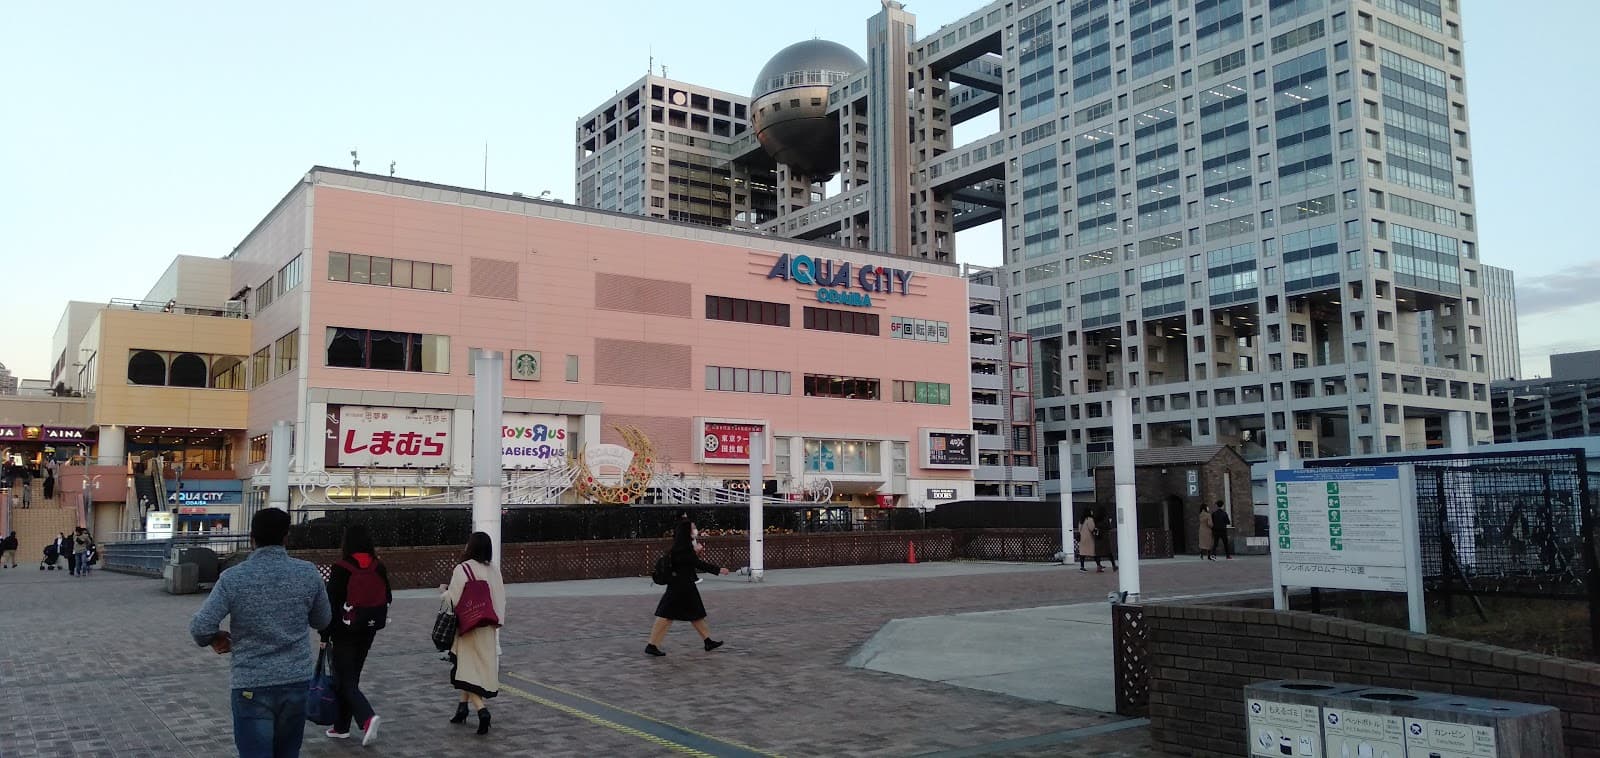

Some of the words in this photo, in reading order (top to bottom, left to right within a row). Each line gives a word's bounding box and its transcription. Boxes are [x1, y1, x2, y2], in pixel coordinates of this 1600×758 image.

[768, 253, 853, 288] AQUA
[891, 322, 902, 332] 6F
[904, 323, 948, 339] 回転寿司
[344, 429, 447, 456] しまむら
[1189, 484, 1197, 495] P
[168, 492, 200, 501] AQUA
